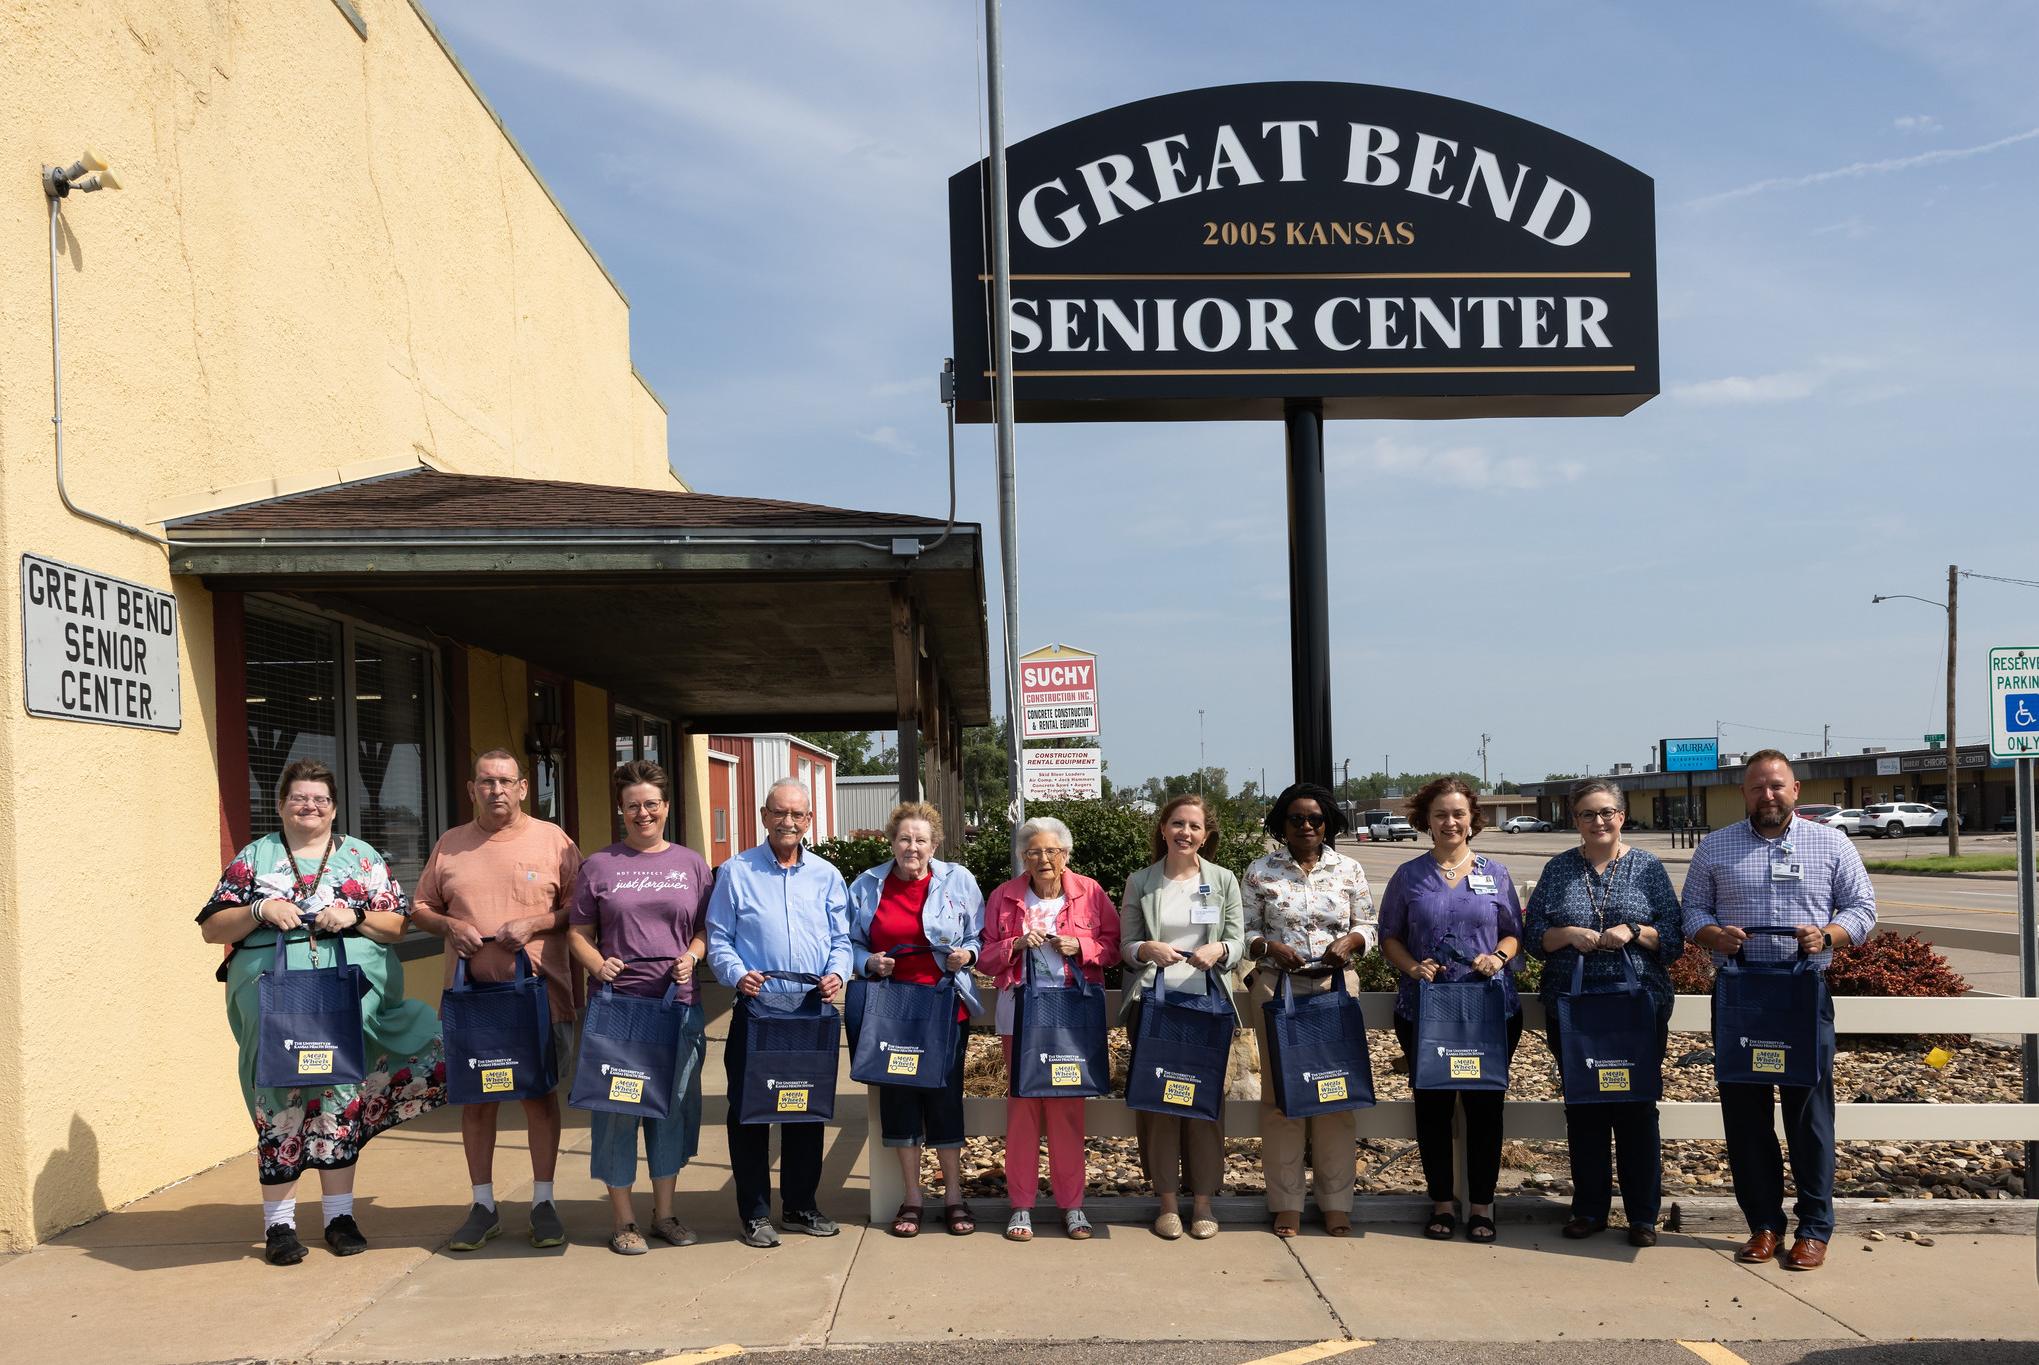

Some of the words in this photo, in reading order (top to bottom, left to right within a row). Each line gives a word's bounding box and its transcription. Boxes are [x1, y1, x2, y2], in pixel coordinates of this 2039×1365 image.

[1018, 120, 1319, 248] GREAT
[1344, 122, 1592, 247] BEND
[1203, 221, 1276, 246] 2005
[1286, 221, 1415, 246] KANSAS
[1010, 297, 1299, 353] SENIOR
[1314, 296, 1613, 352] CENTER
[29, 563, 108, 621] GREAT
[118, 586, 172, 636] BEND
[65, 622, 147, 675] SENIOR
[1024, 665, 1091, 688] SUCHY
[1997, 675, 2039, 690] PARKIN
[61, 670, 152, 720] CENTER
[1026, 692, 1076, 704] CONSTRUCTION
[1078, 691, 1092, 701] INC.
[1027, 709, 1053, 720] CONCRETE
[1054, 707, 1093, 718] CONSTRUCTION
[1032, 722, 1037, 731] &
[1039, 720, 1059, 730] RENTAL
[1060, 718, 1089, 729] EQUIPMENT
[1676, 743, 1715, 753] MURRAY
[2008, 736, 2039, 750] ONLY
[612, 878, 639, 893] just
[637, 876, 689, 891] forgiven
